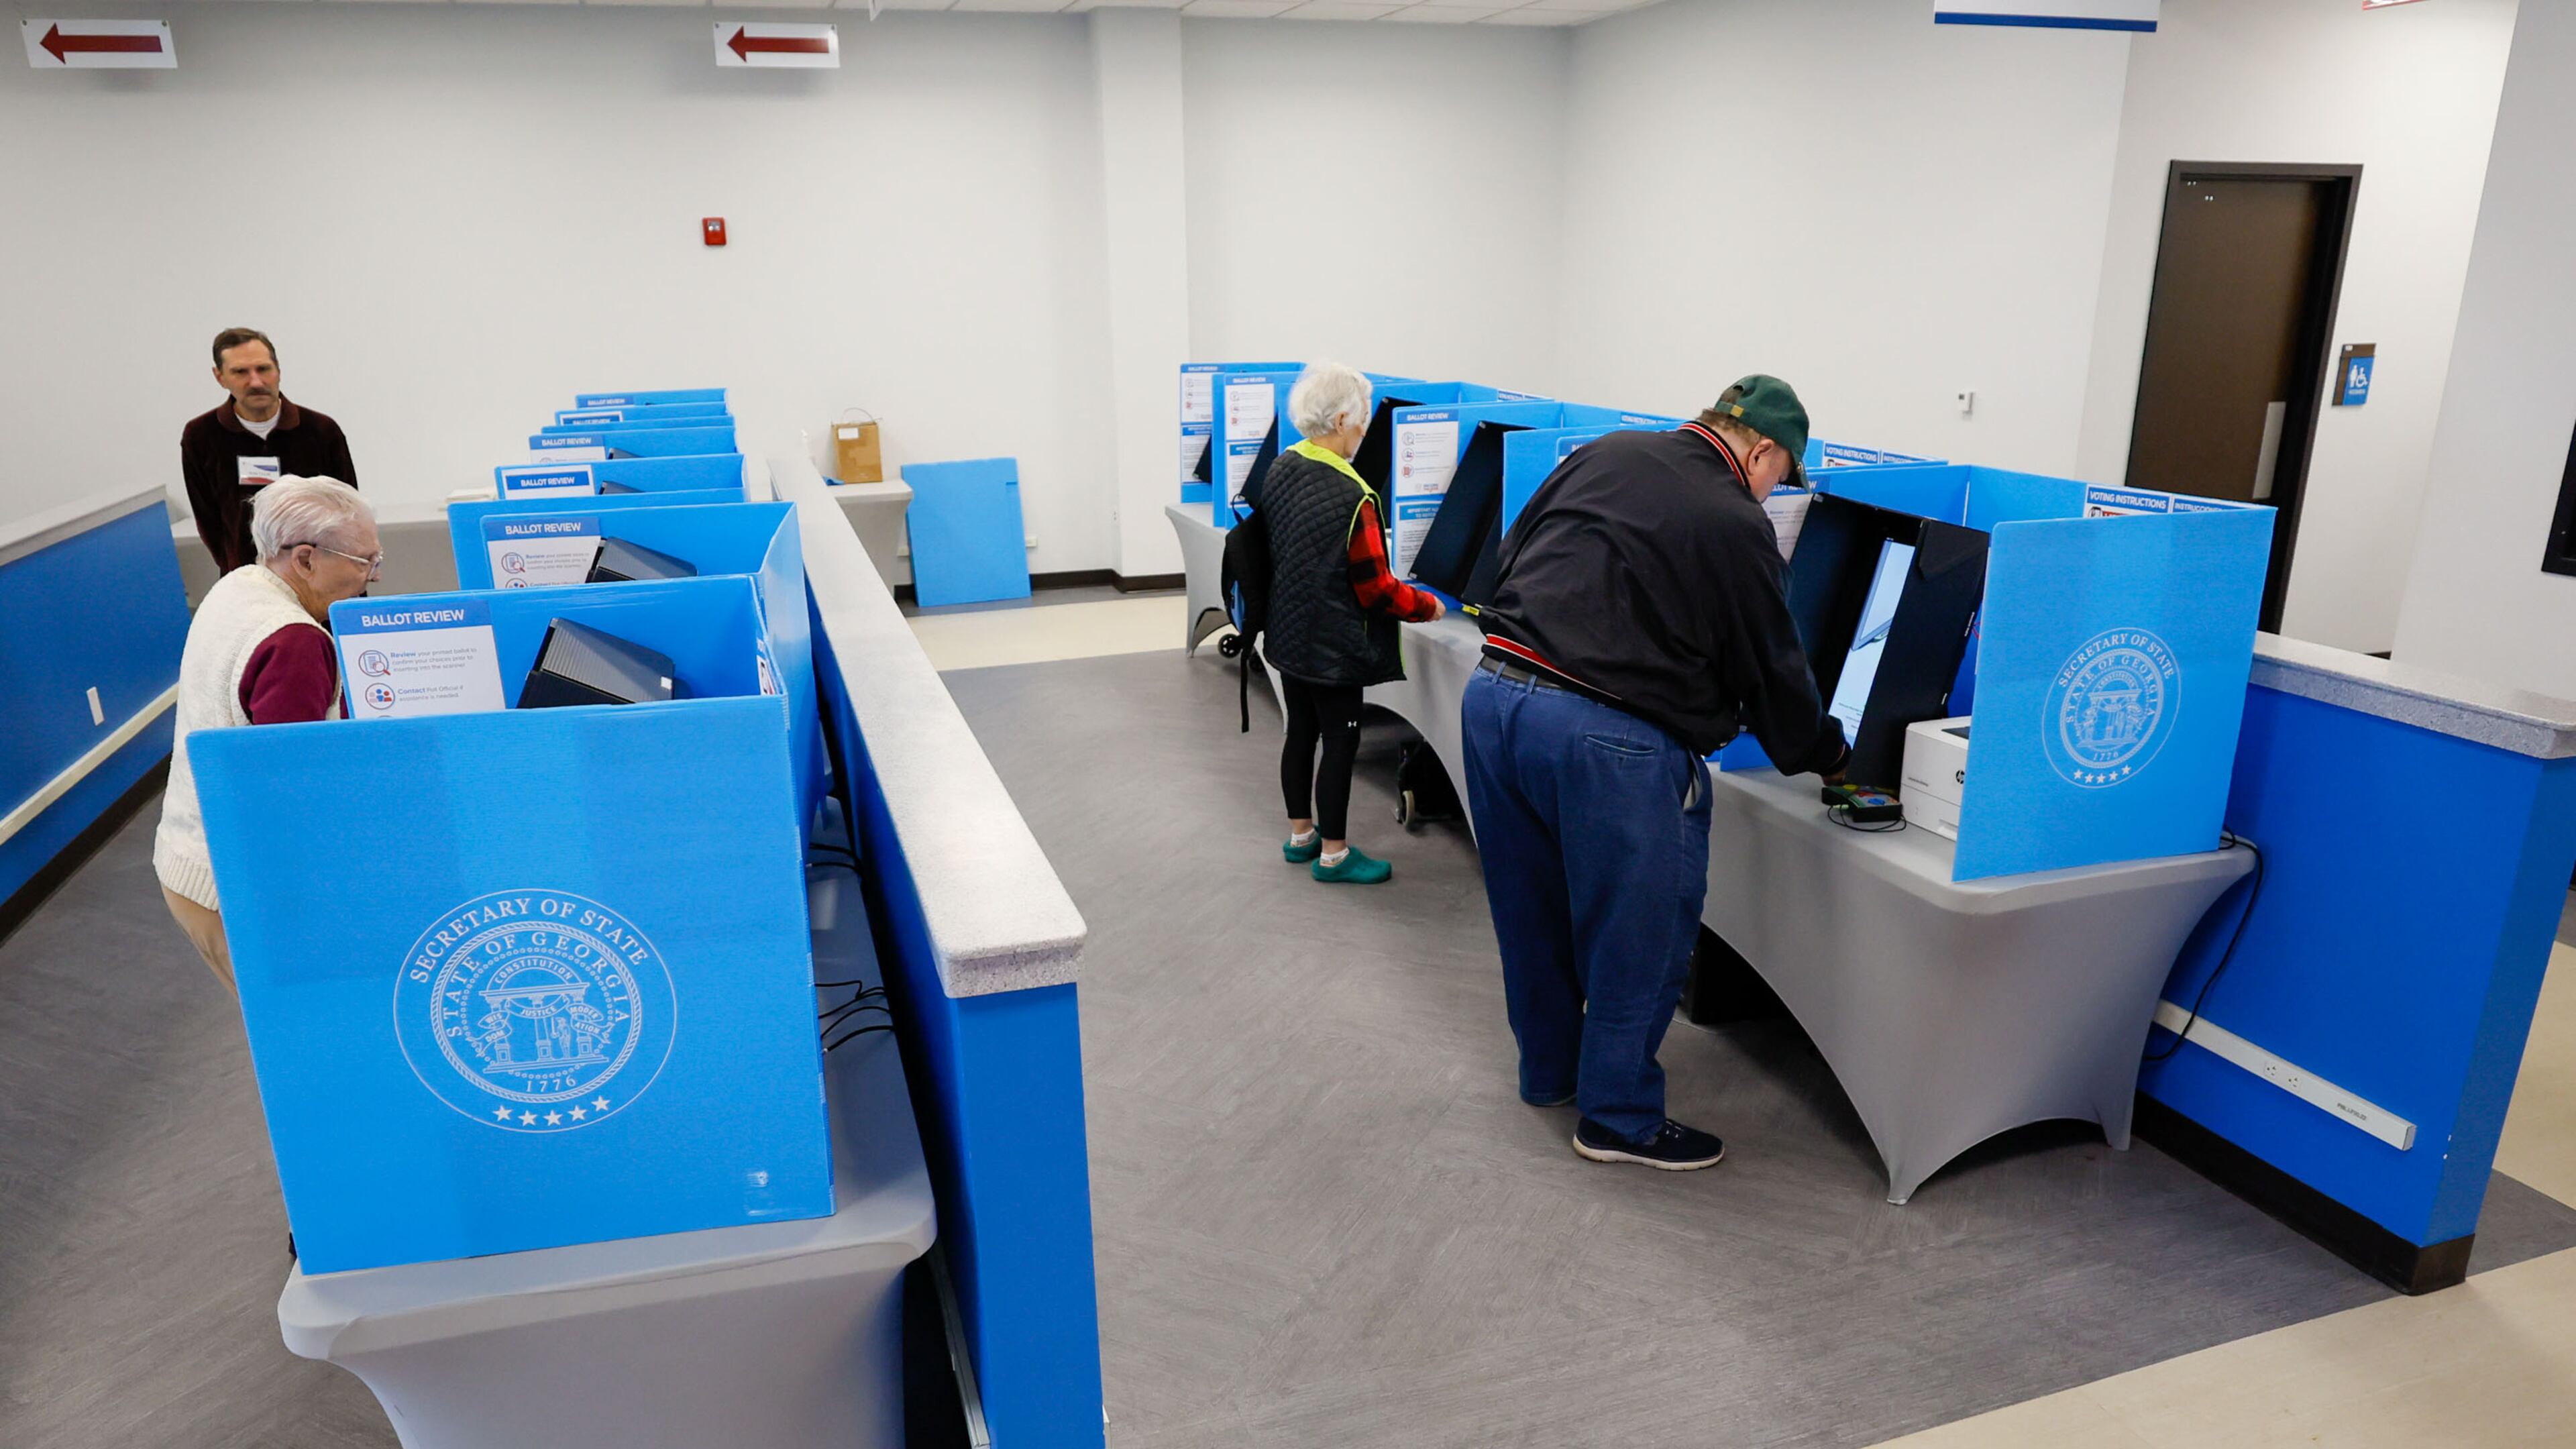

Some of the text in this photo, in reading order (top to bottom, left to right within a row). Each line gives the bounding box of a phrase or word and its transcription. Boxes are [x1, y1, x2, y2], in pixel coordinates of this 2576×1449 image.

[1827, 446, 1878, 462] VOTING INSTRUCTIONS
[521, 477, 575, 487] BALLOT REVIEW
[2090, 491, 2166, 509] VOTING INSTRUCTIONS
[505, 522, 581, 535] BALLOT REVIEW
[362, 609, 464, 627] BALLOT REVIEW
[2059, 633, 2174, 688] SECRETARY OF STATE
[2066, 655, 2158, 723] STATE OF GEORGIA
[410, 898, 649, 984] SECRETARY OF STATE
[494, 959, 573, 984] CONSTITUTION
[442, 931, 631, 1038] STATE OF GEORGIA
[485, 1013, 502, 1024] WIS
[521, 1006, 557, 1016] JUSTICE
[571, 1006, 598, 1020] MODER
[485, 1029, 505, 1042] DOM
[575, 1022, 601, 1034] ATION
[525, 1075, 576, 1093] 1776
